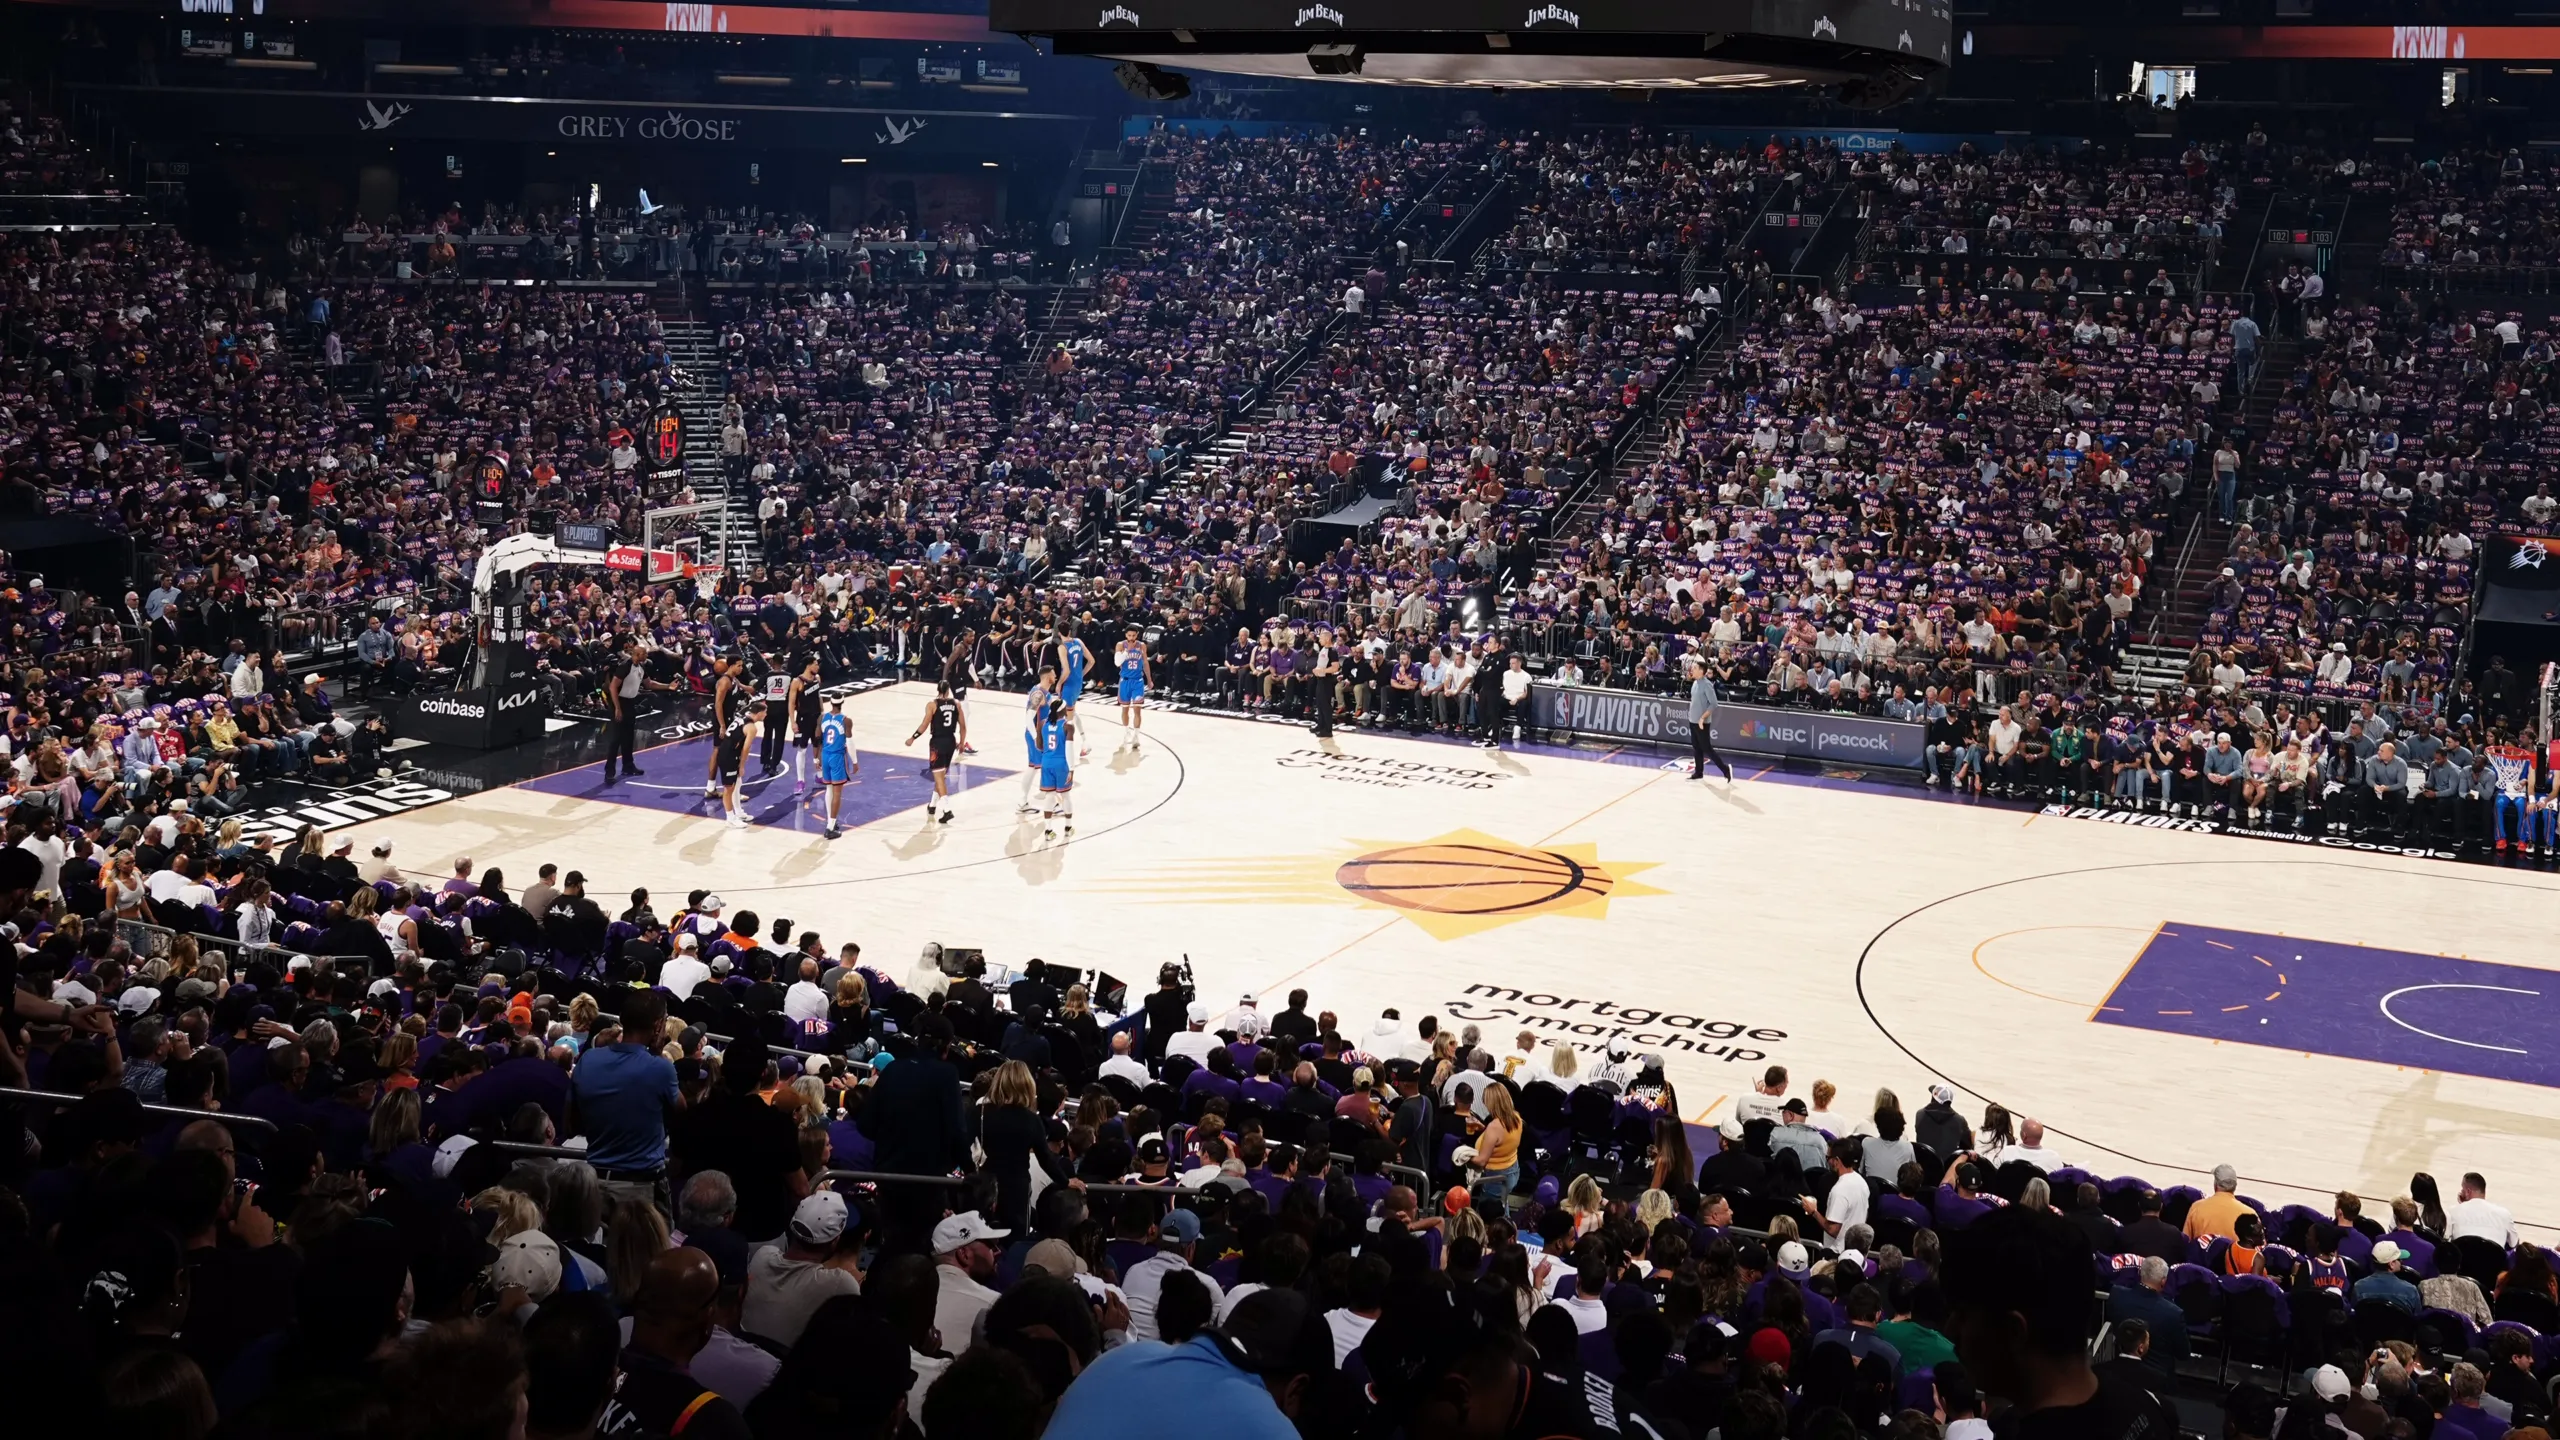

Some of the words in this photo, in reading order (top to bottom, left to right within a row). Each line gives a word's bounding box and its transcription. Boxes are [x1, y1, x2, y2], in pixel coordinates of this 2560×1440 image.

[1099, 8, 1115, 27] JIM
[1116, 5, 1139, 28] BEAM
[1295, 9, 1315, 27] JIM
[1315, 4, 1344, 27] BEAM
[1525, 9, 1547, 28] JIM
[1548, 4, 1580, 29] BEAM
[1812, 19, 1823, 37] JIM
[1823, 15, 1837, 40] BEAM
[558, 116, 630, 137] GREY
[638, 118, 735, 140] GOOSE
[1867, 137, 1892, 149] Ban
[1769, 215, 1781, 224] 101
[1806, 216, 1819, 225] 102
[2272, 232, 2287, 240] 102
[2315, 233, 2330, 242] 103
[659, 432, 677, 460] 14
[658, 469, 682, 479] TISSOT
[568, 526, 599, 542] PLAYOFFS
[493, 606, 505, 617] GET
[512, 605, 522, 617] GET
[493, 618, 505, 629] THE
[512, 617, 522, 628] THE
[496, 630, 507, 643] App
[1073, 653, 1079, 668] 7
[1128, 660, 1138, 670] 25
[820, 677, 898, 698] LTRA
[420, 697, 486, 718] coinbase
[1571, 694, 1662, 737] PLAYOFFS
[943, 711, 953, 727] 3
[827, 730, 836, 744] 2
[1666, 719, 1719, 740] Goe
[1769, 726, 1807, 744] NBC
[1048, 734, 1056, 750] 5
[1818, 732, 1889, 751] peacock
[1291, 748, 1514, 780] mortgage
[1320, 774, 1412, 789] center
[1324, 764, 1494, 790] matchup
[215, 782, 453, 847] SUNS
[2067, 807, 2221, 834] PLAYOFFS
[2226, 826, 2295, 840] Presented
[2295, 834, 2313, 843] by
[2318, 837, 2457, 860] Google
[1463, 983, 1789, 1042] mortgage
[1519, 1014, 1767, 1063] matchup
